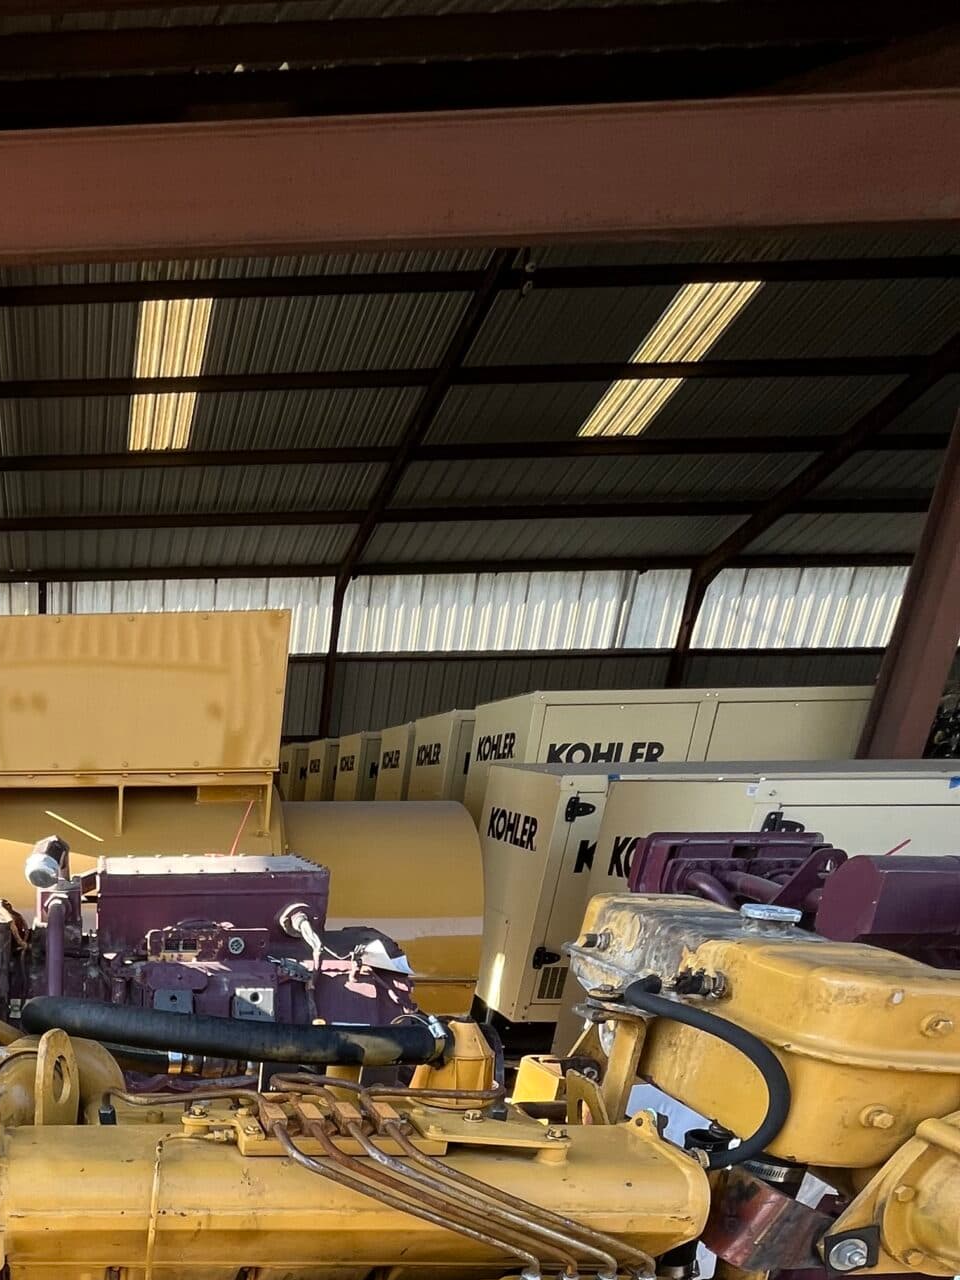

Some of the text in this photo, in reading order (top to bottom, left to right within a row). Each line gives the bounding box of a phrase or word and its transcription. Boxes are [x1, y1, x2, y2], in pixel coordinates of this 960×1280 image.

[416, 743, 441, 766] KOHLER
[476, 732, 516, 762] KOHLER
[546, 742, 665, 764] KOHLER
[488, 807, 538, 851] KOHLER
